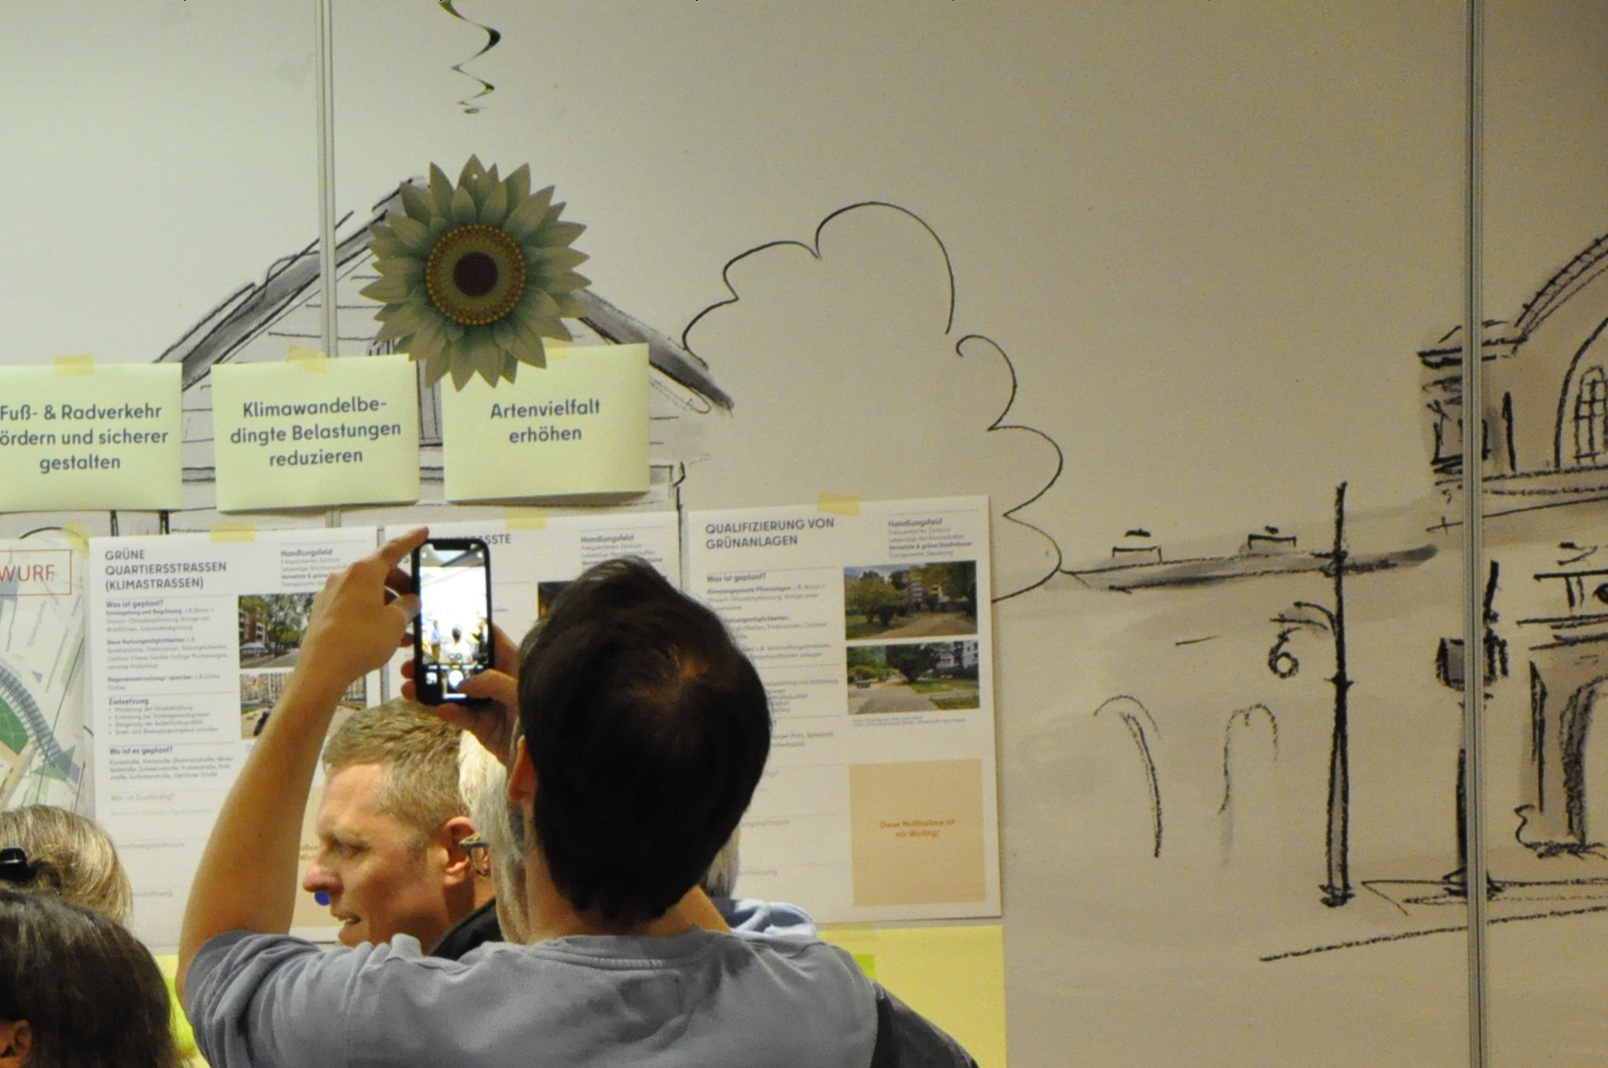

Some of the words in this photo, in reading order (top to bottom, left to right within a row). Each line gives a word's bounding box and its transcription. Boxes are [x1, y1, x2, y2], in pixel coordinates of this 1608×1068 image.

[0, 404, 37, 422] Fuß-
[44, 405, 56, 421] &
[61, 403, 162, 421] Radverkehr
[242, 397, 387, 419] Klimawandelbe-
[490, 397, 601, 419] Artenvielfalt
[61, 429, 94, 446] und
[99, 428, 168, 446] sicherer
[230, 424, 287, 446] dingte
[292, 420, 401, 443] Belastungen
[509, 423, 582, 444] erhöhen
[39, 454, 121, 474] gestalten
[269, 448, 363, 468] reduzieren
[706, 519, 805, 534] QUALIFIZIERUNG
[808, 518, 834, 529] VON
[888, 517, 943, 527] Handlungsfeld
[581, 534, 634, 543] Handlungsfeld
[706, 535, 798, 549] GRÜNANLAGEN
[105, 547, 145, 561] GRÜNE
[281, 548, 333, 556] Handlungsfeld
[105, 562, 227, 575] QUARTIERSSTRASSEN
[105, 577, 204, 593] (KLIMASTRASSEN)
[734, 573, 766, 582] geplant?
[132, 600, 163, 609] geplant?
[108, 698, 149, 706] Zielsetzung
[142, 746, 173, 756] geplant?
